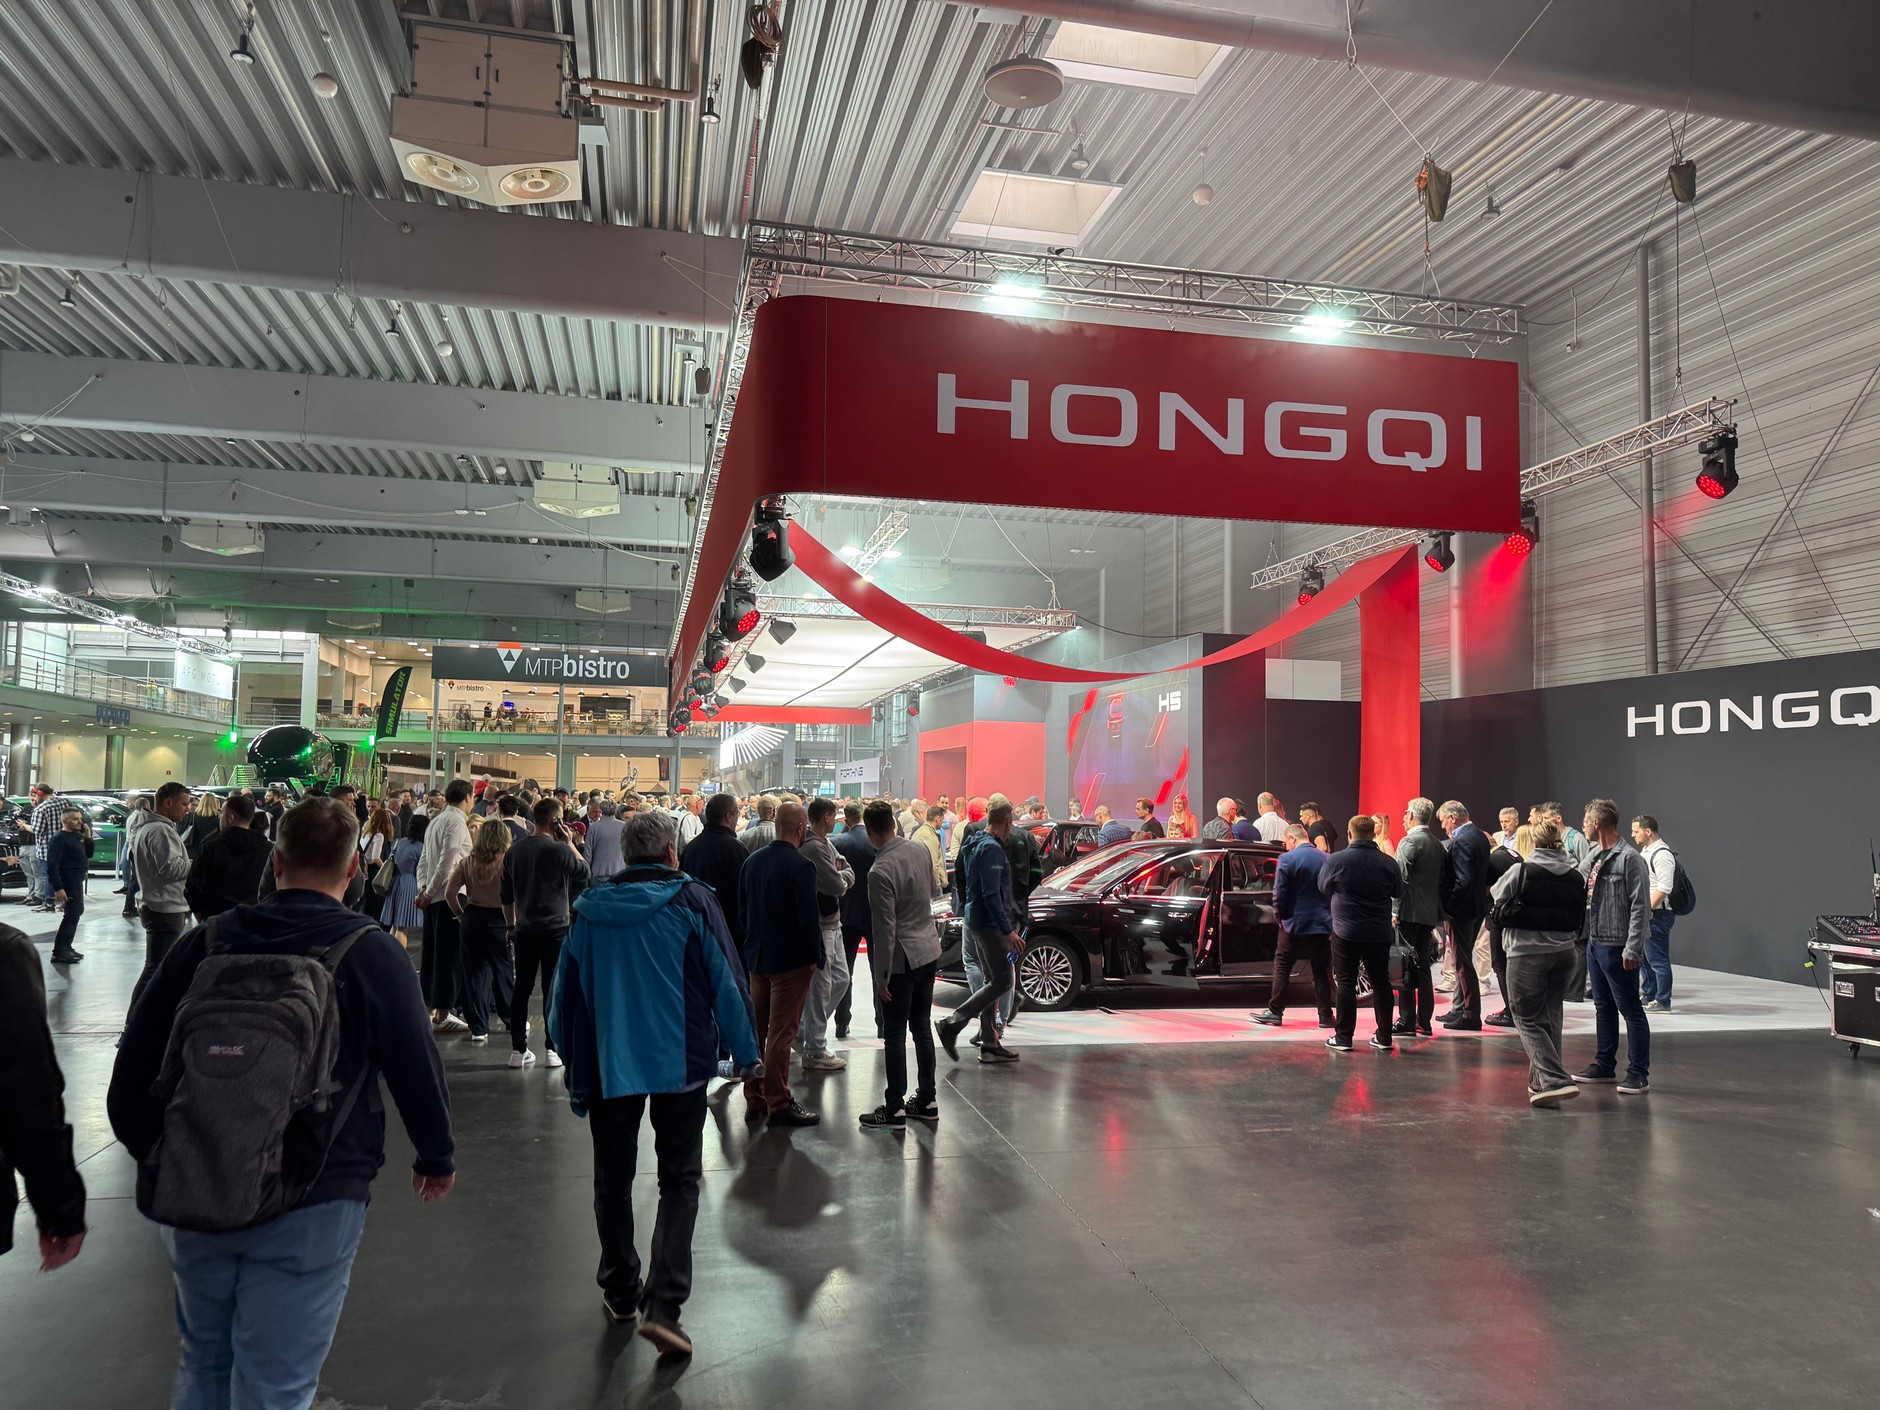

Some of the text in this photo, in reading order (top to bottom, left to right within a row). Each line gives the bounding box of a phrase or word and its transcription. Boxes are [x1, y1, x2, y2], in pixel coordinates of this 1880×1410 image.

[937, 372, 1482, 472] HONGQI
[525, 654, 630, 679] MTPbistro
[386, 671, 407, 735] SIMULATOR
[1627, 685, 1880, 738] HONGQ
